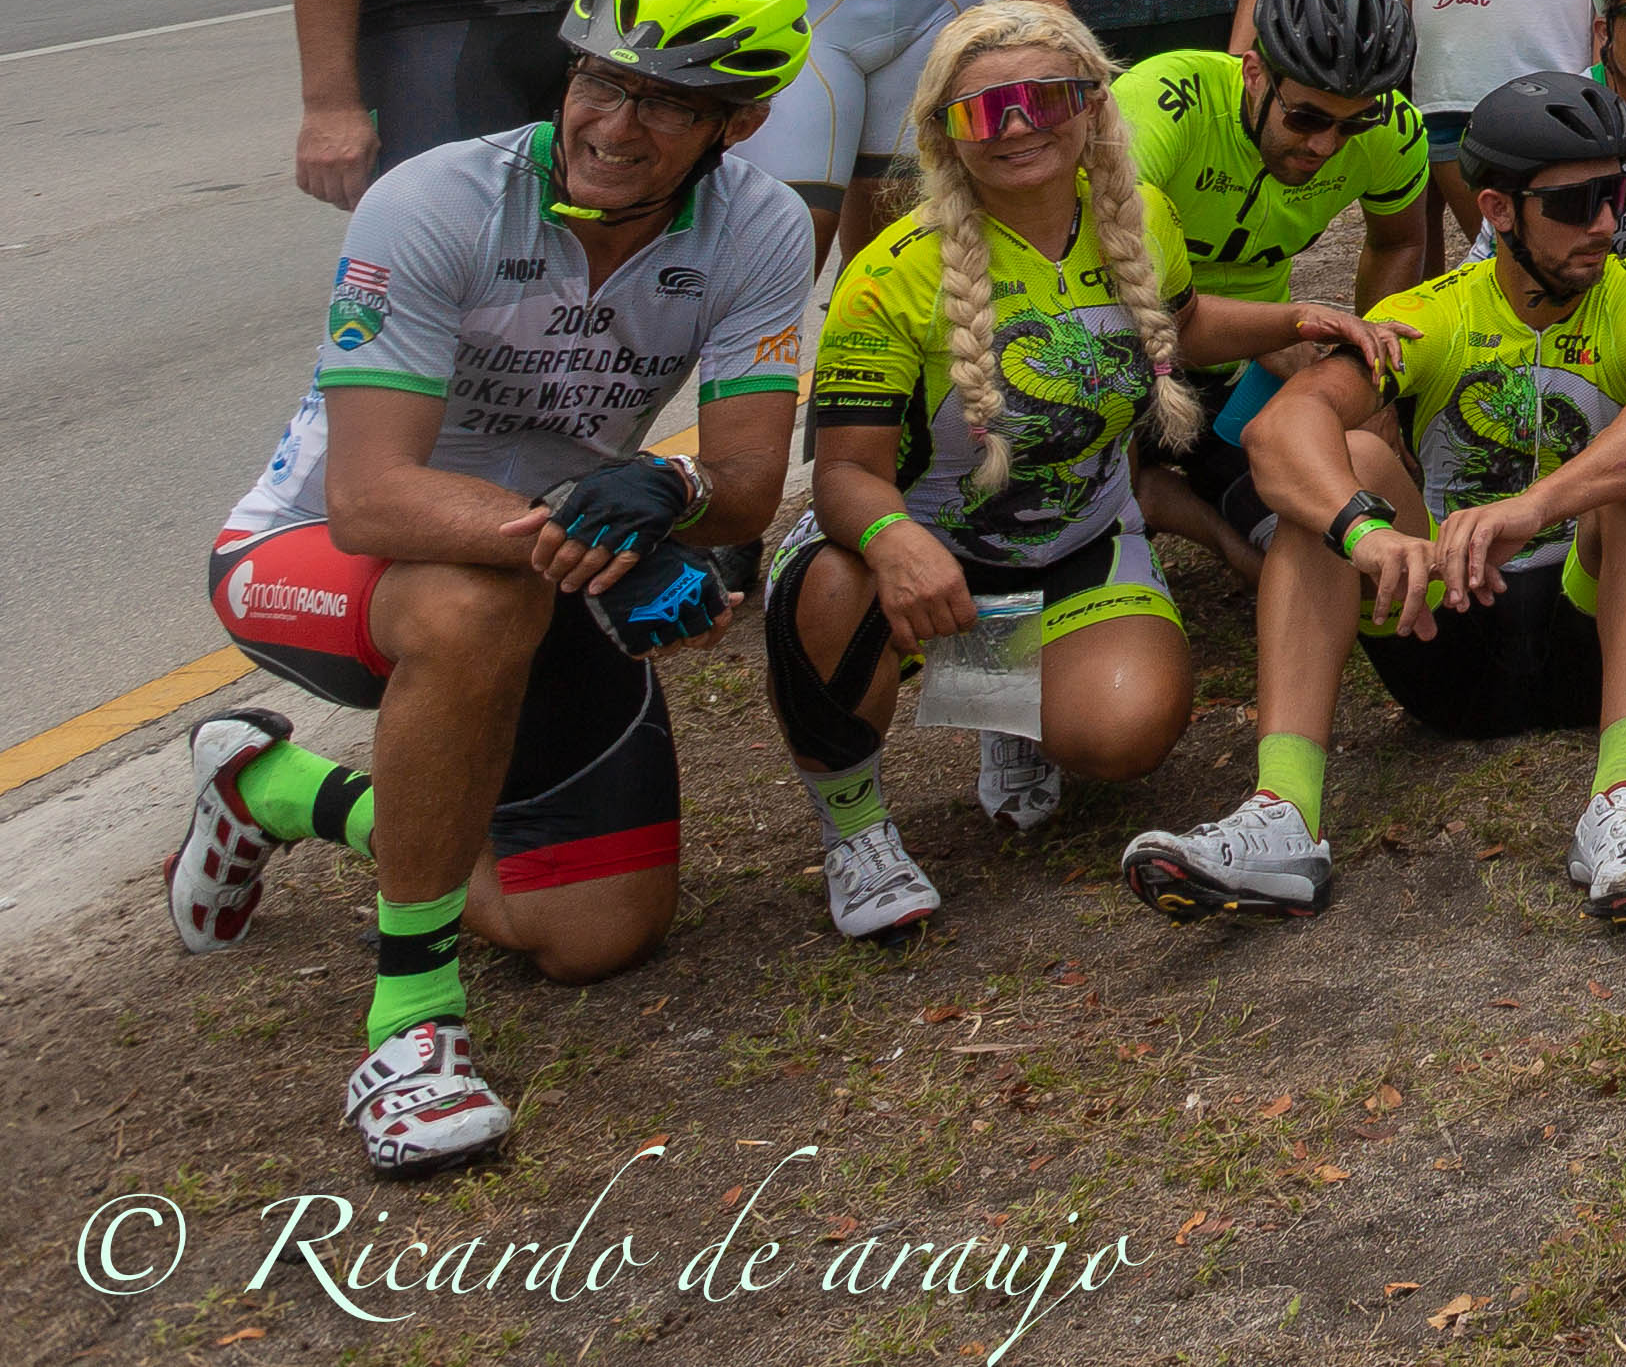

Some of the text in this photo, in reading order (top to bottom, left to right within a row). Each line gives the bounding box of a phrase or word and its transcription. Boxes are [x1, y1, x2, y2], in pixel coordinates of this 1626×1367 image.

[1555, 333, 1591, 351] CITY
[488, 342, 689, 377] DEERFIELD BEACH
[835, 369, 886, 383] BIKES
[469, 379, 655, 411] KEY WEST RIDE
[459, 409, 516, 435] 215
